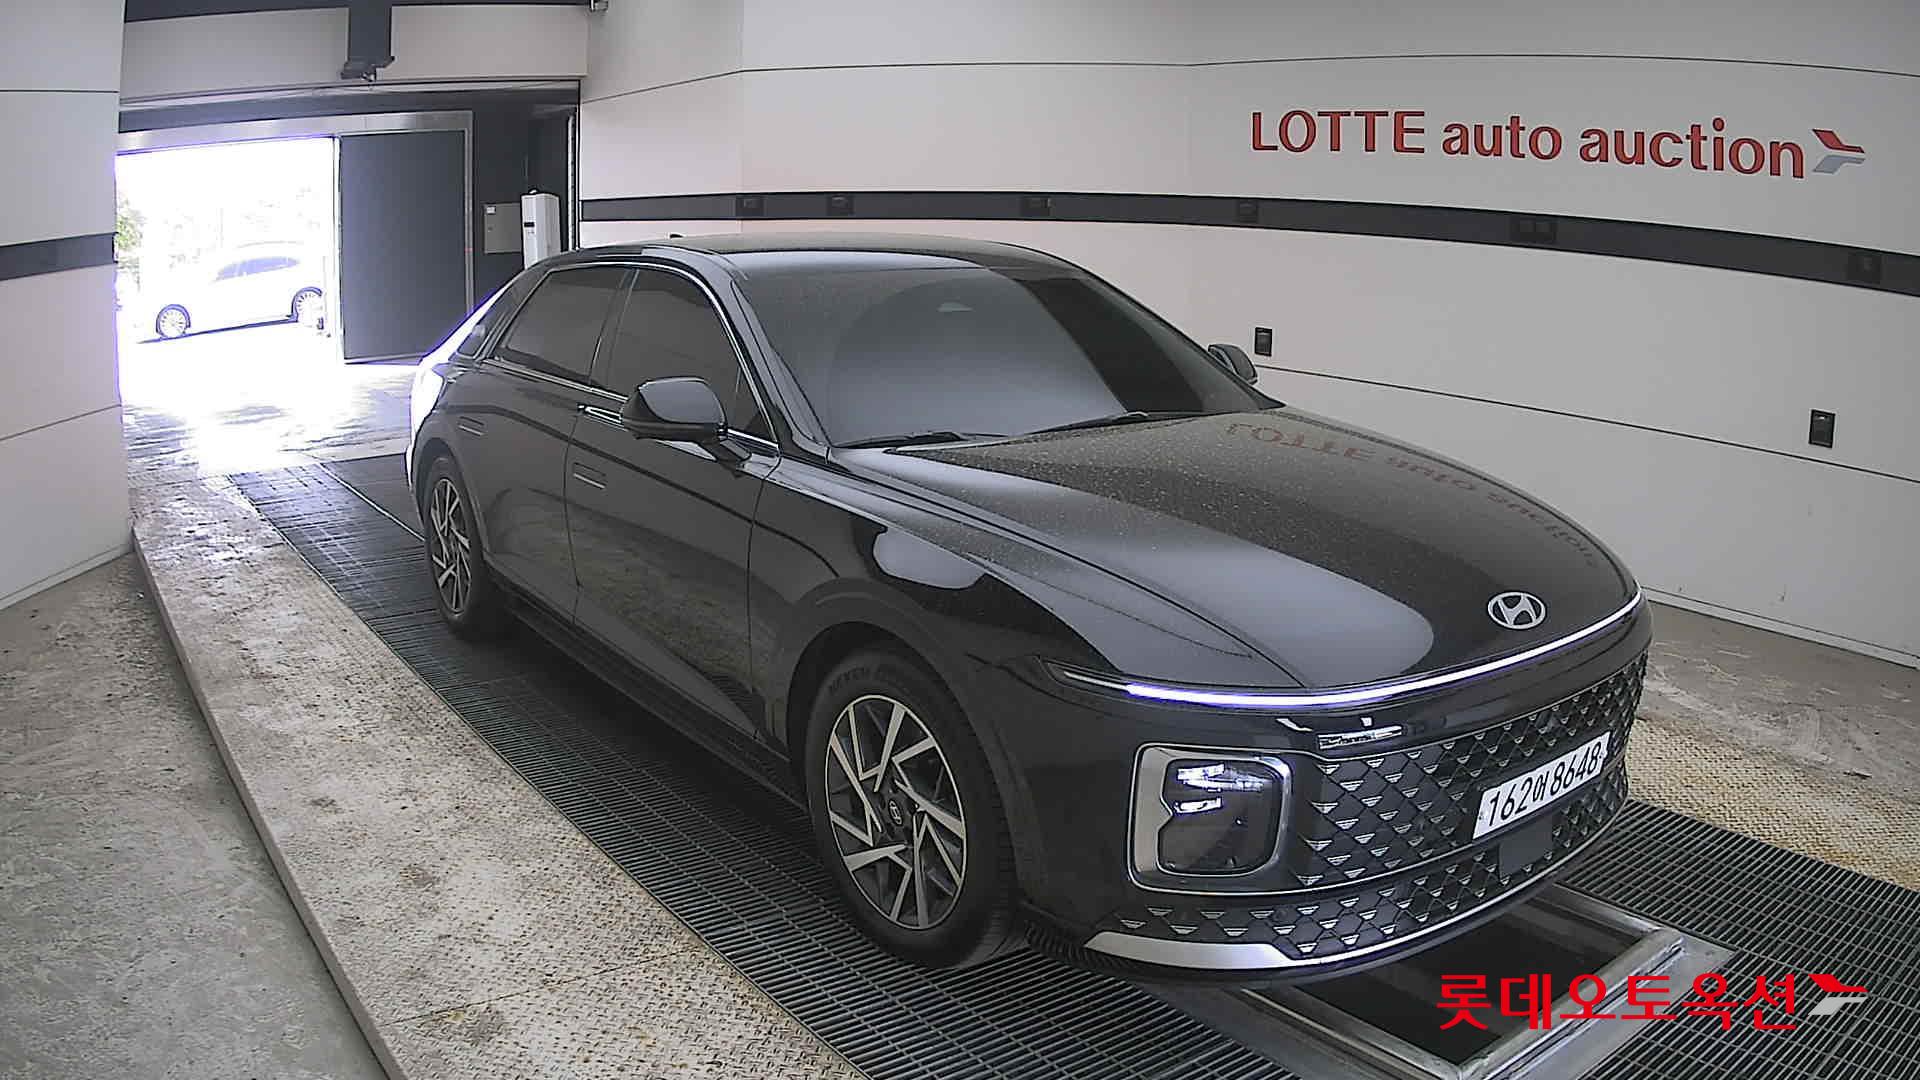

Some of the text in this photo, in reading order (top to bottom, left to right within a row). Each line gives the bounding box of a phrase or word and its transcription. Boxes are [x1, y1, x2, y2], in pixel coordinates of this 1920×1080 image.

[1252, 110, 1805, 179] LOTTE auto auction
